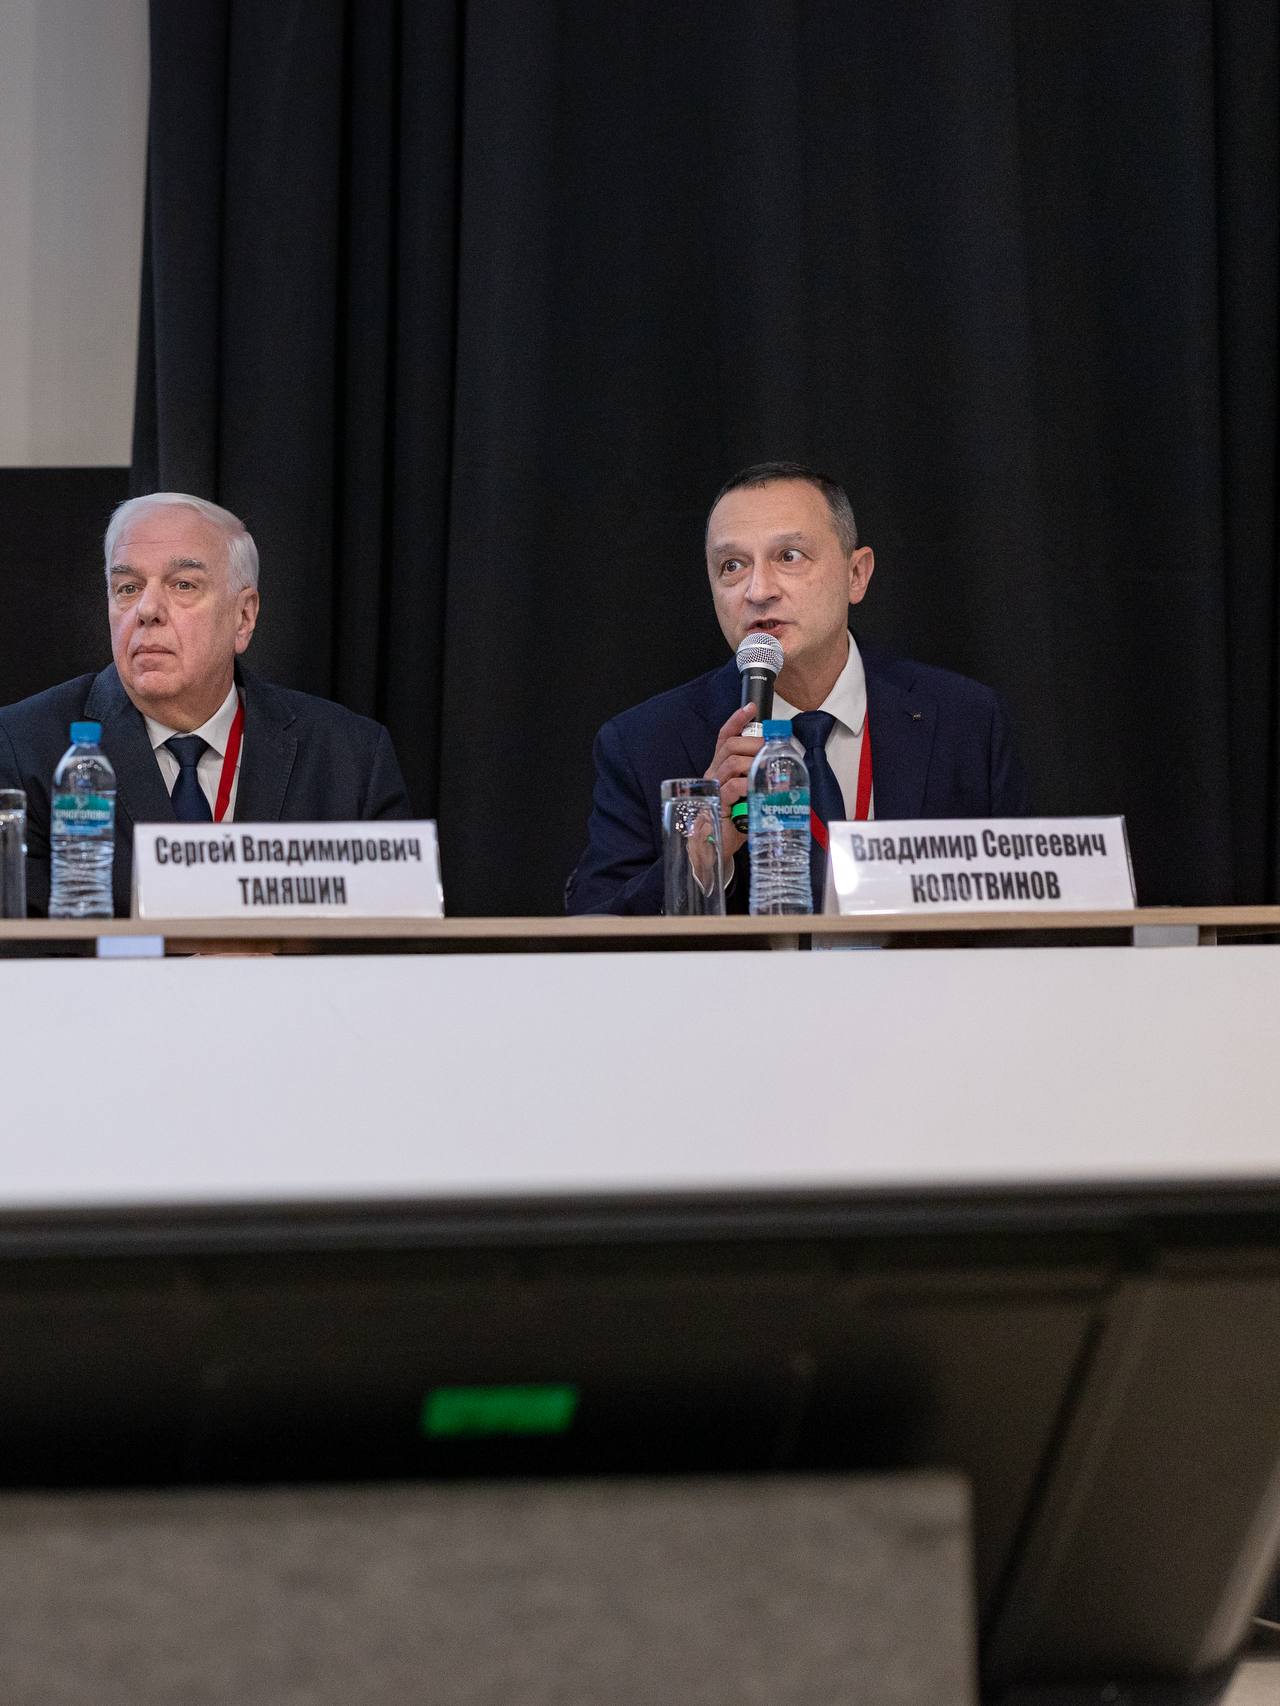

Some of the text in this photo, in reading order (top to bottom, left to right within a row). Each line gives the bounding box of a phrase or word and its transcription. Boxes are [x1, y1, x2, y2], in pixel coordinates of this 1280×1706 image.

[155, 835, 422, 866] Сергей Владимирович
[851, 829, 1107, 864] Владимир Сергеевич
[238, 876, 348, 905] ТАНЯШИН
[911, 870, 1061, 903] КОЛОТВИНОВ
